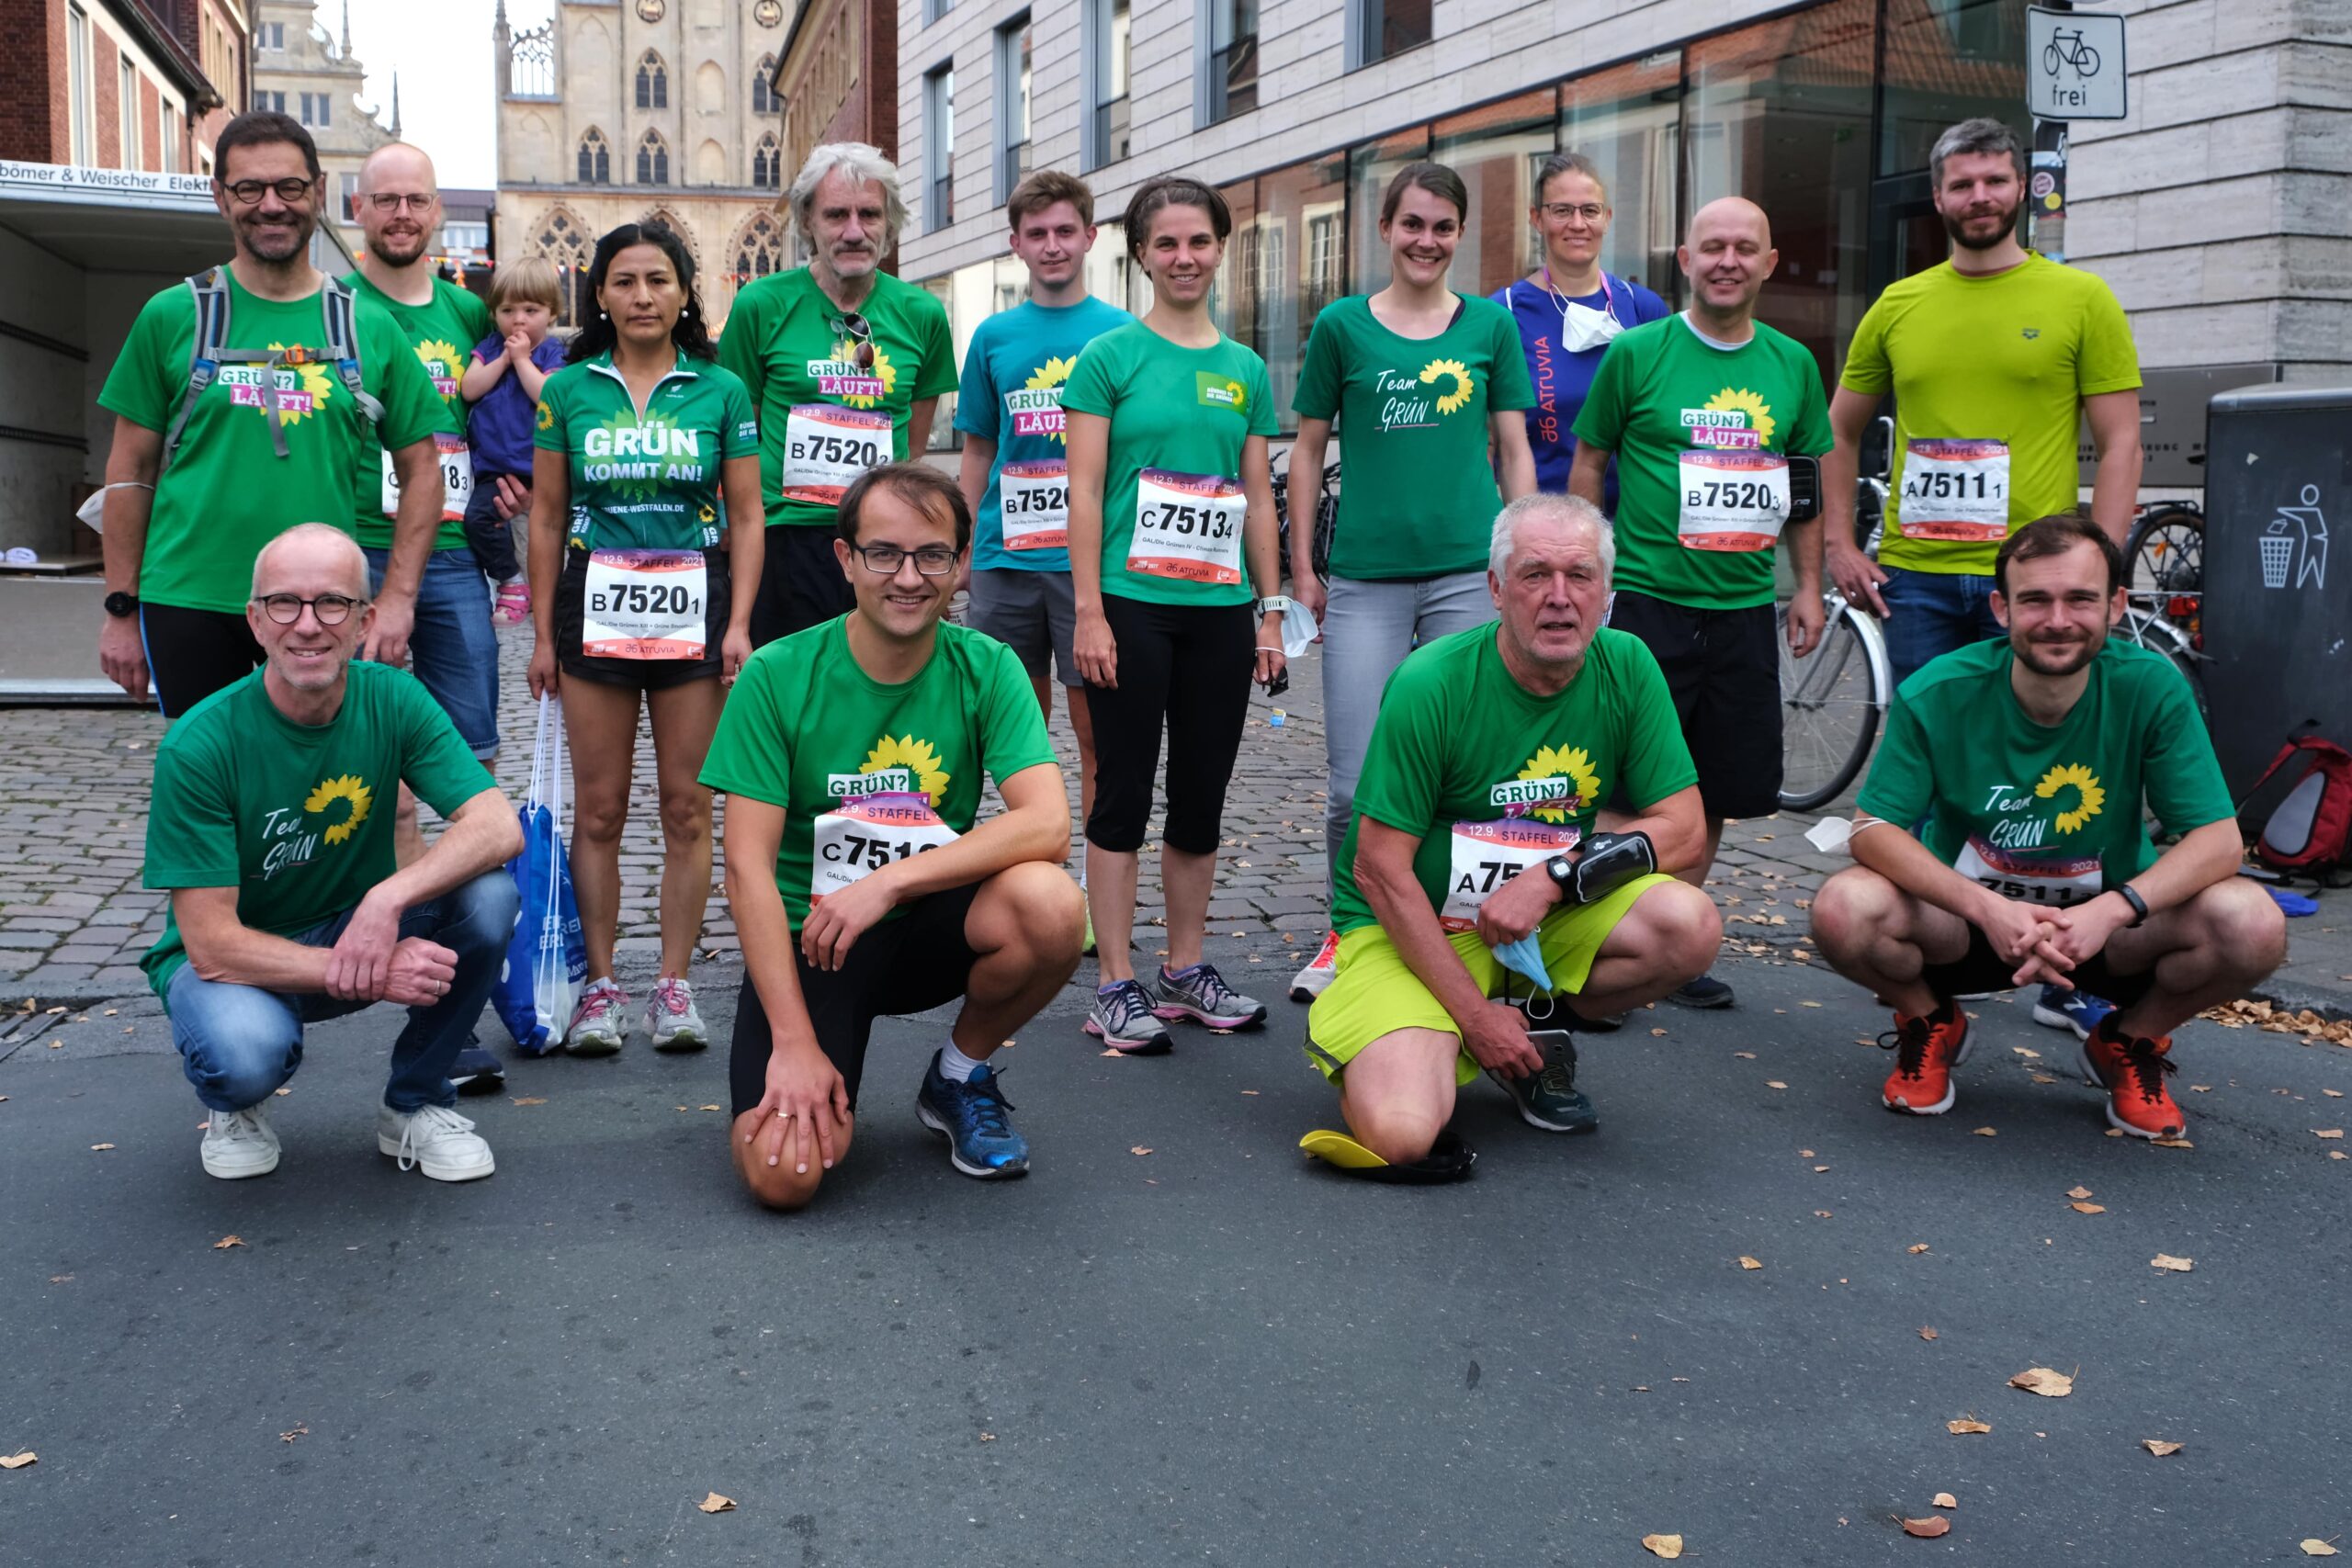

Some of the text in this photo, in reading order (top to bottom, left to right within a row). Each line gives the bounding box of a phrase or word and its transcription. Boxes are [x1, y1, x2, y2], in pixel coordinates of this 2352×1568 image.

[2052, 85, 2086, 107] frei
[62, 169, 74, 183] &
[81, 170, 158, 188] Weischer
[820, 378, 883, 396] LÄUFT!
[1376, 369, 1419, 393] Team
[233, 386, 311, 412] LÄFT!
[1009, 389, 1061, 411] GRÜN
[826, 412, 871, 426] STAFFEL
[1019, 412, 1066, 433] LÄUF
[1381, 397, 1430, 433] GRÜN
[1683, 412, 1744, 428] GRÜN?
[584, 421, 699, 457] GRÜN
[1693, 427, 1758, 447] LÄUFT!
[1935, 447, 1981, 457] STAFFEL
[584, 462, 703, 482] KOMMT AN!
[1153, 475, 1175, 486] 12.9.
[604, 555, 705, 568] 12.9. STAFFEL 2021
[830, 773, 907, 795] GRÜN?
[1493, 781, 1566, 804] GRÜN?
[263, 808, 302, 840] Tea
[867, 807, 931, 821] STAFFEL
[1468, 826, 1497, 837] 12.9.
[1501, 830, 1555, 845] STAFFEL
[1989, 815, 2047, 848] GRÜN
[2070, 860, 2100, 873] 2021
